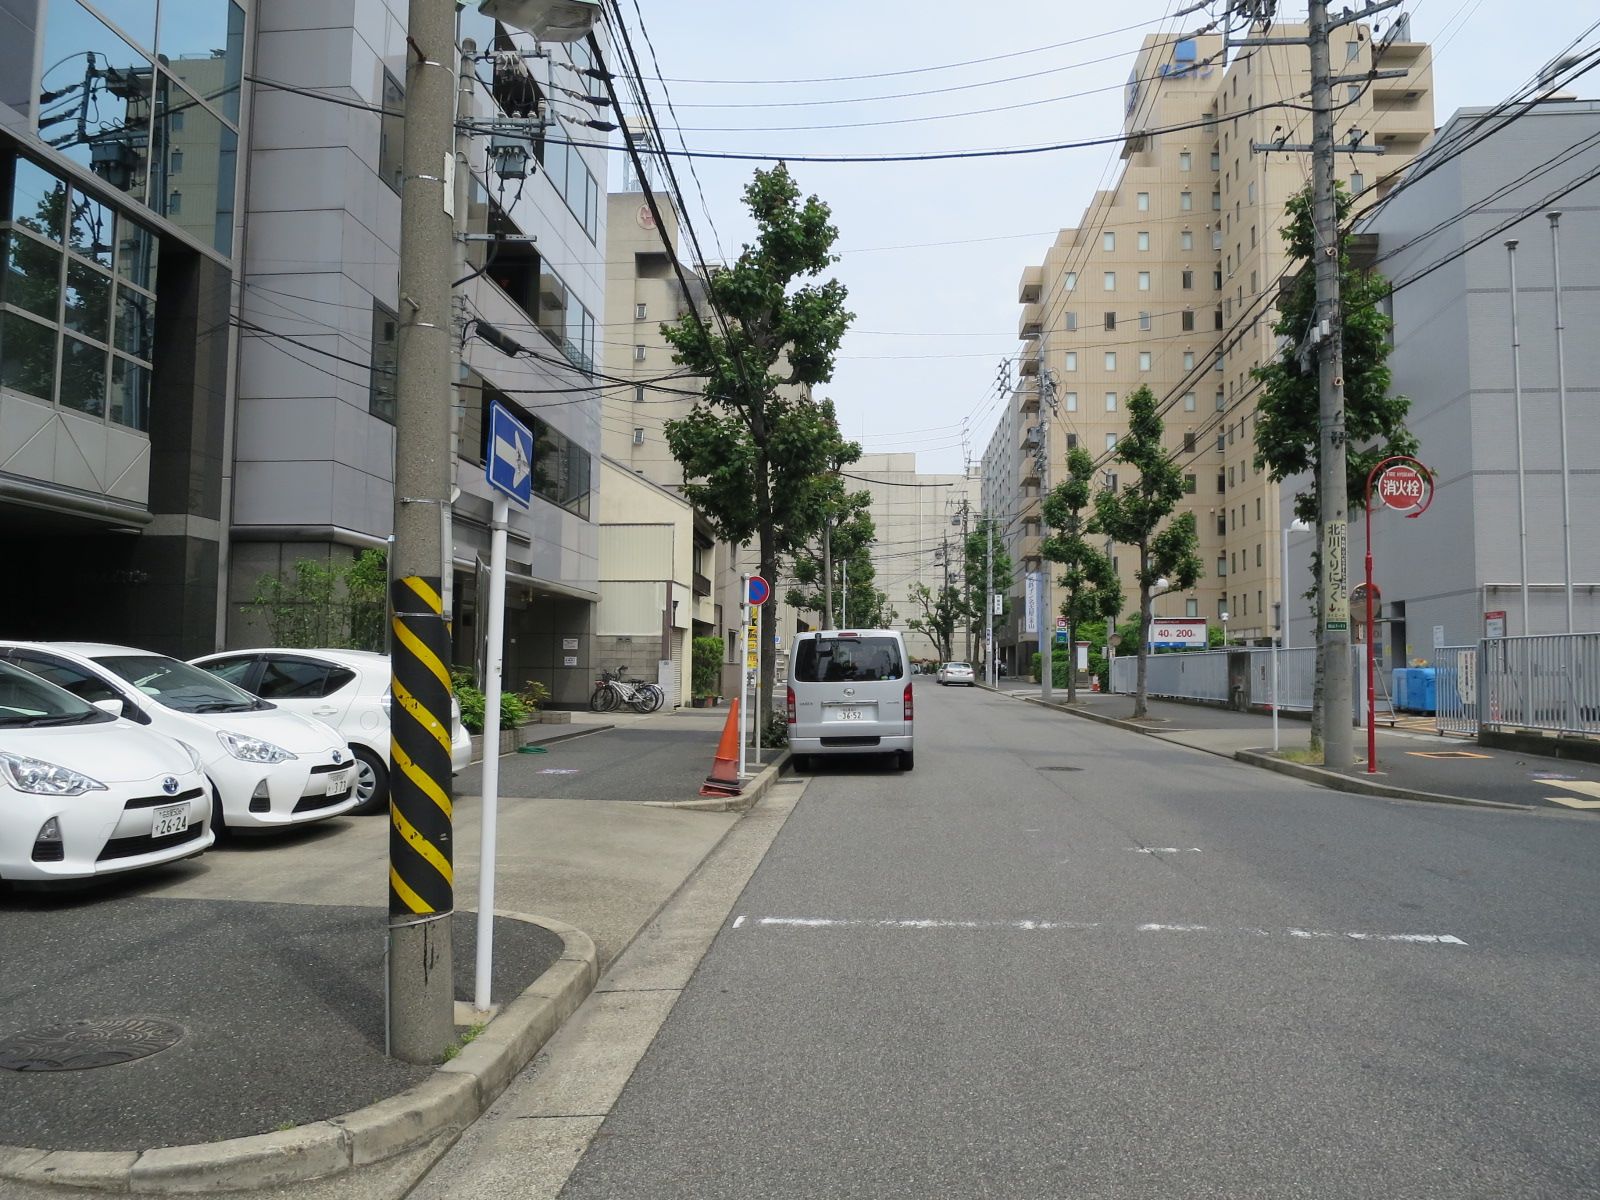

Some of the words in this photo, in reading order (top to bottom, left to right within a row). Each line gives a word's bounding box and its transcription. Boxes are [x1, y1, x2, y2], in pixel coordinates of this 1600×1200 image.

[1383, 479, 1420, 497] 消火栓
[1328, 523, 1341, 602] 北川くりにっく
[1158, 629, 1169, 638] 40
[1176, 629, 1193, 638] 200
[160, 815, 187, 835] 26-24
